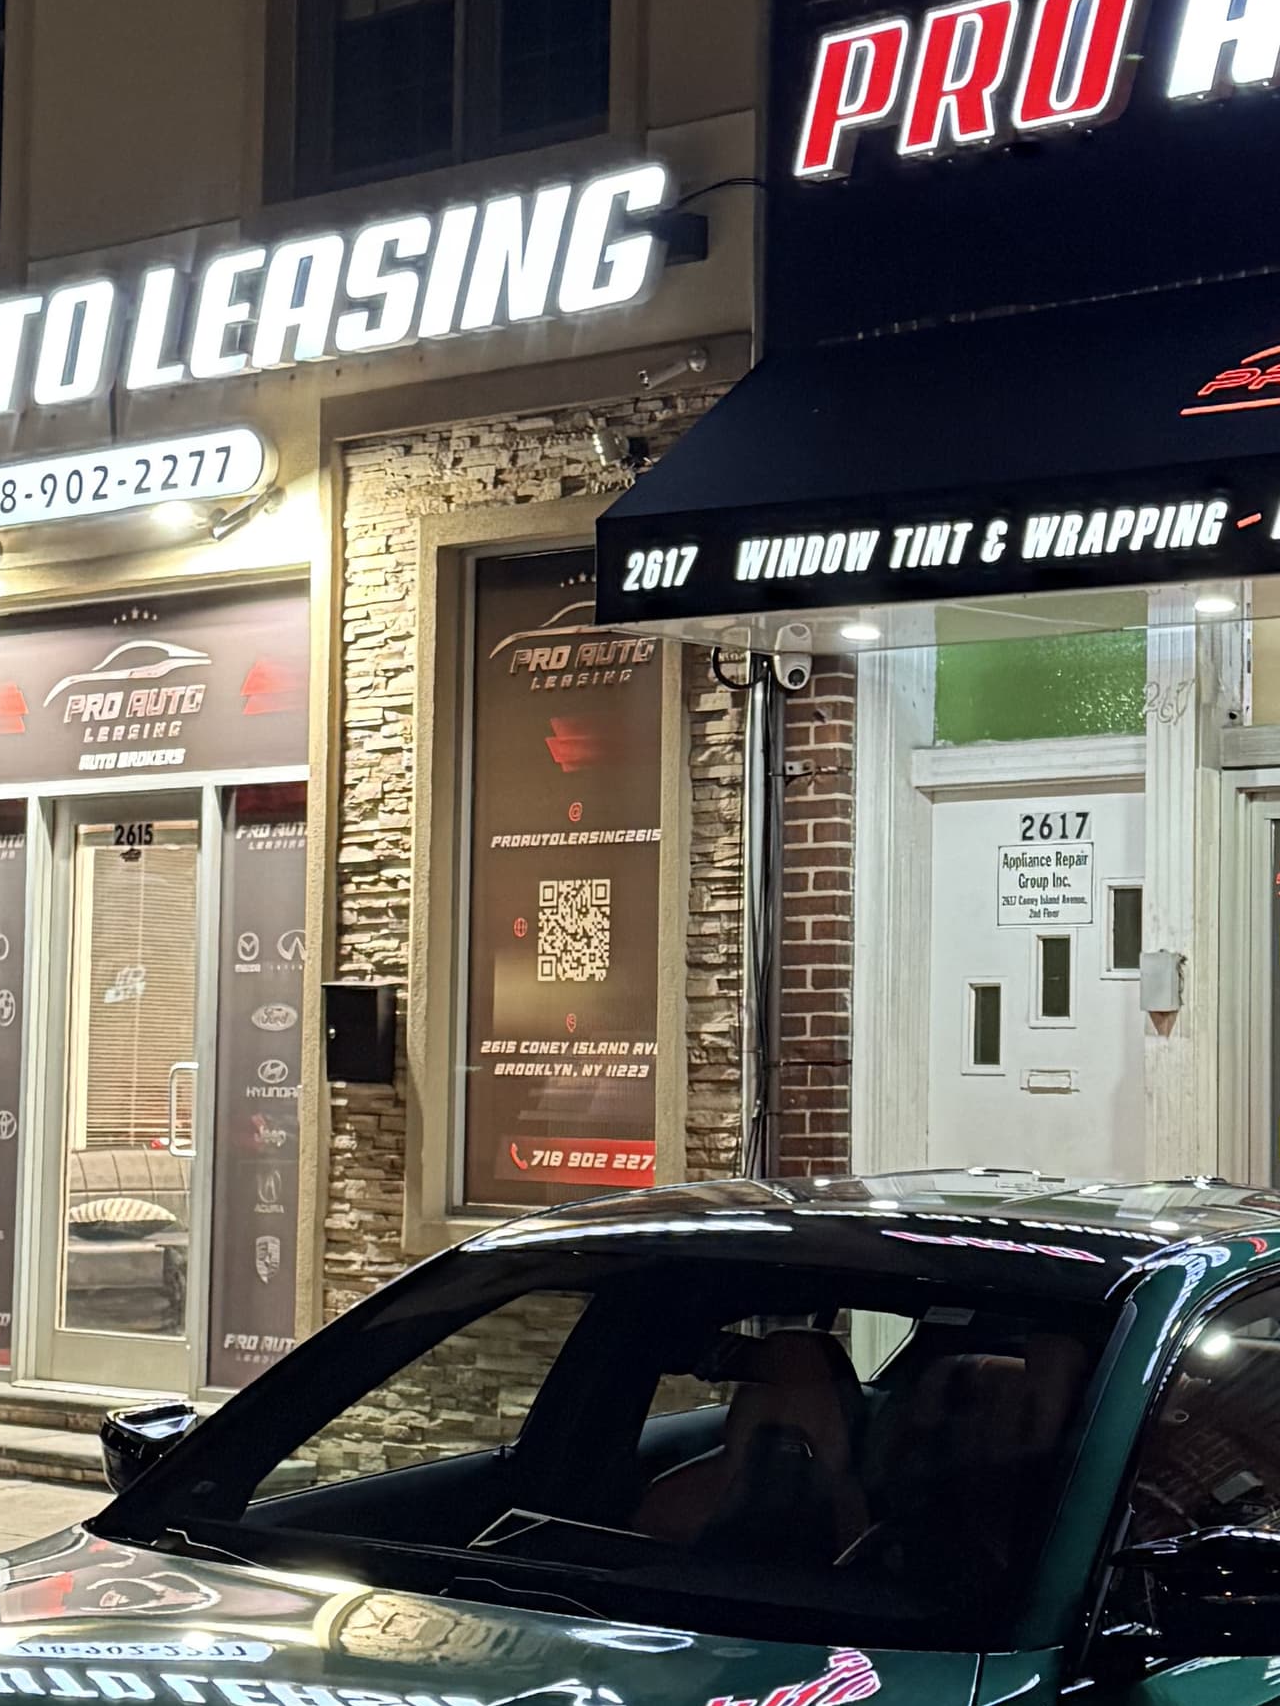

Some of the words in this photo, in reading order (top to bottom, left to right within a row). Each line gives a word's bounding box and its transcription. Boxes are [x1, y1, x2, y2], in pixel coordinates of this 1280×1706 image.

[126, 164, 668, 391] LEASING
[735, 530, 881, 581] WINDOW
[889, 522, 974, 569] TINT
[980, 520, 1009, 564] &
[1021, 500, 1229, 560] WRAPPING
[623, 545, 699, 592] 2617
[509, 645, 571, 675] PRO
[575, 637, 658, 669] AUTO
[64, 691, 124, 723] PRO
[126, 684, 206, 718] AUTO
[83, 721, 182, 743] LEASING
[114, 823, 154, 845] 2615
[272, 822, 307, 837] AUT
[1021, 812, 1091, 842] 2617
[490, 828, 663, 848] PROAUTOLEASING2615
[1002, 852, 1052, 871] Appliance
[1055, 850, 1089, 869] Repair
[1018, 873, 1049, 891] Group
[1052, 872, 1071, 888] Inc.
[1018, 895, 1038, 906] Coney
[1040, 894, 1060, 905] Island
[1029, 908, 1041, 919] 2nd
[1043, 908, 1060, 918] Floor
[480, 1040, 517, 1054] 2615
[520, 1041, 570, 1054] CONEY
[573, 1042, 629, 1055] ISLAND
[494, 1063, 579, 1078] BROOKLYN,
[582, 1064, 605, 1077] NY
[606, 1064, 650, 1078] 11223
[530, 1150, 564, 1167] 718
[568, 1152, 608, 1168] 902
[612, 1153, 657, 1171] 227
[224, 1334, 259, 1350] PRO
